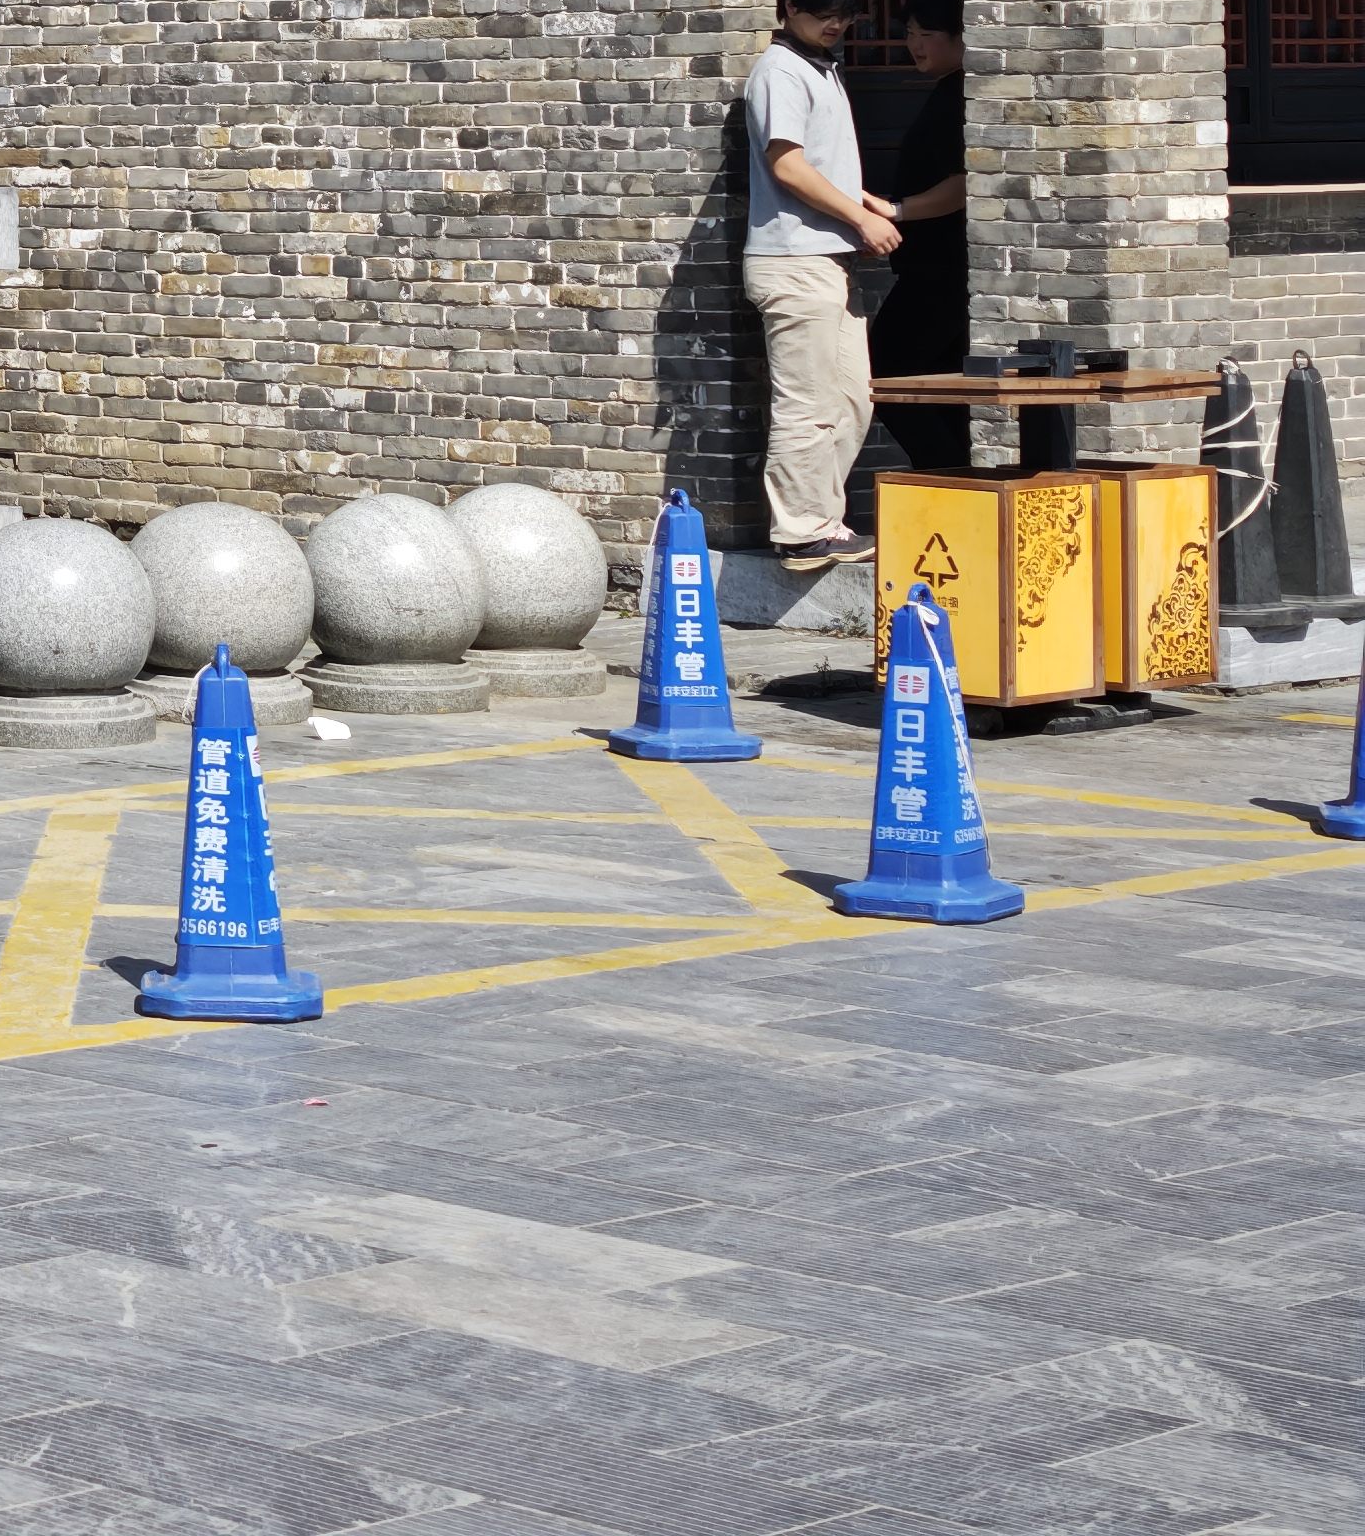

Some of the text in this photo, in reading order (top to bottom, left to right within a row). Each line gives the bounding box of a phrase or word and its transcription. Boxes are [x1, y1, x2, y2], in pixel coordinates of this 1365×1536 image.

[674, 589, 705, 681] 日丰管
[892, 708, 928, 822] 日丰管
[191, 738, 232, 913] 管道免费清洗
